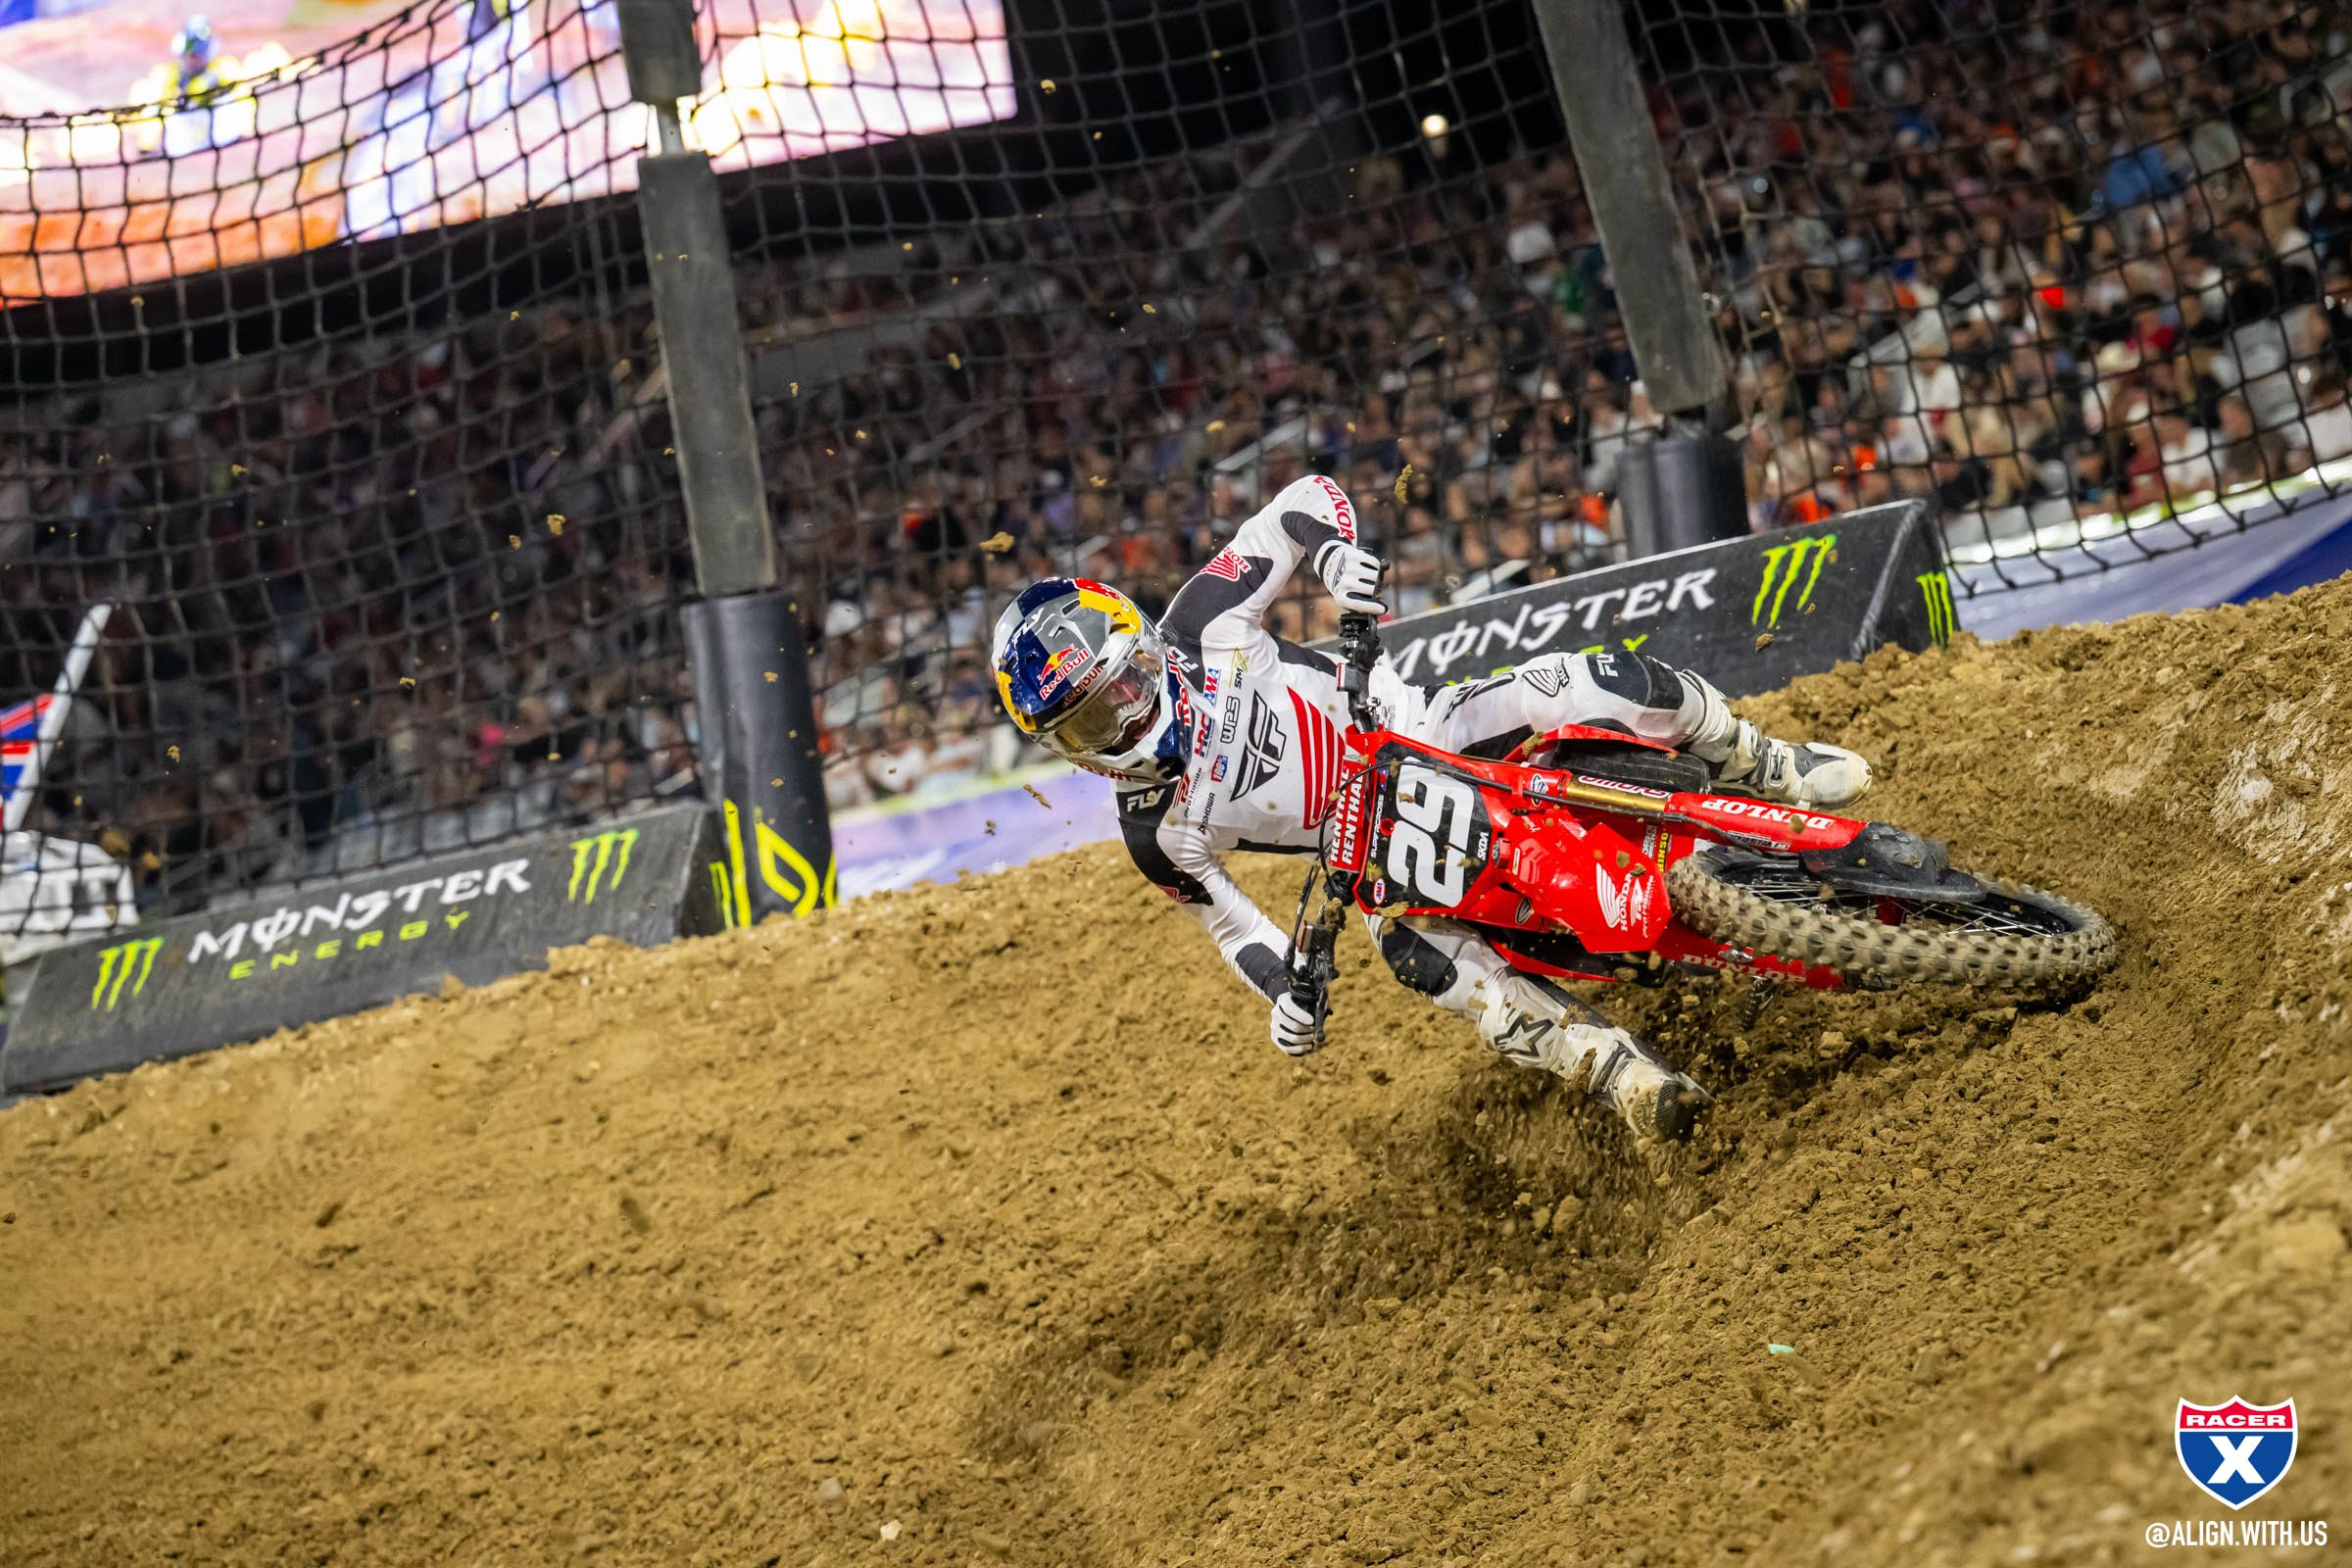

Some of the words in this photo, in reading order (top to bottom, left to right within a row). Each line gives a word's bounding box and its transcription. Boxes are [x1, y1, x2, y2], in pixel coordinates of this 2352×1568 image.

[1223, 546, 1250, 571] HON
[1039, 670, 1064, 702] Red
[1062, 648, 1091, 677] Bull
[1231, 648, 1250, 689] SMX
[1596, 654, 1618, 677] FL
[1203, 667, 1221, 708] AMA
[1194, 711, 1215, 760] HRC
[1220, 695, 1241, 745] WPS
[1212, 755, 1228, 782] 100%
[1201, 792, 1216, 828] SHOWA
[1342, 770, 1365, 866] RENTHAL
[1700, 798, 1836, 830] DUNLOP
[1387, 756, 1475, 908] 29
[228, 909, 470, 980] ENERGY
[1683, 953, 1808, 985] DUNLOP
